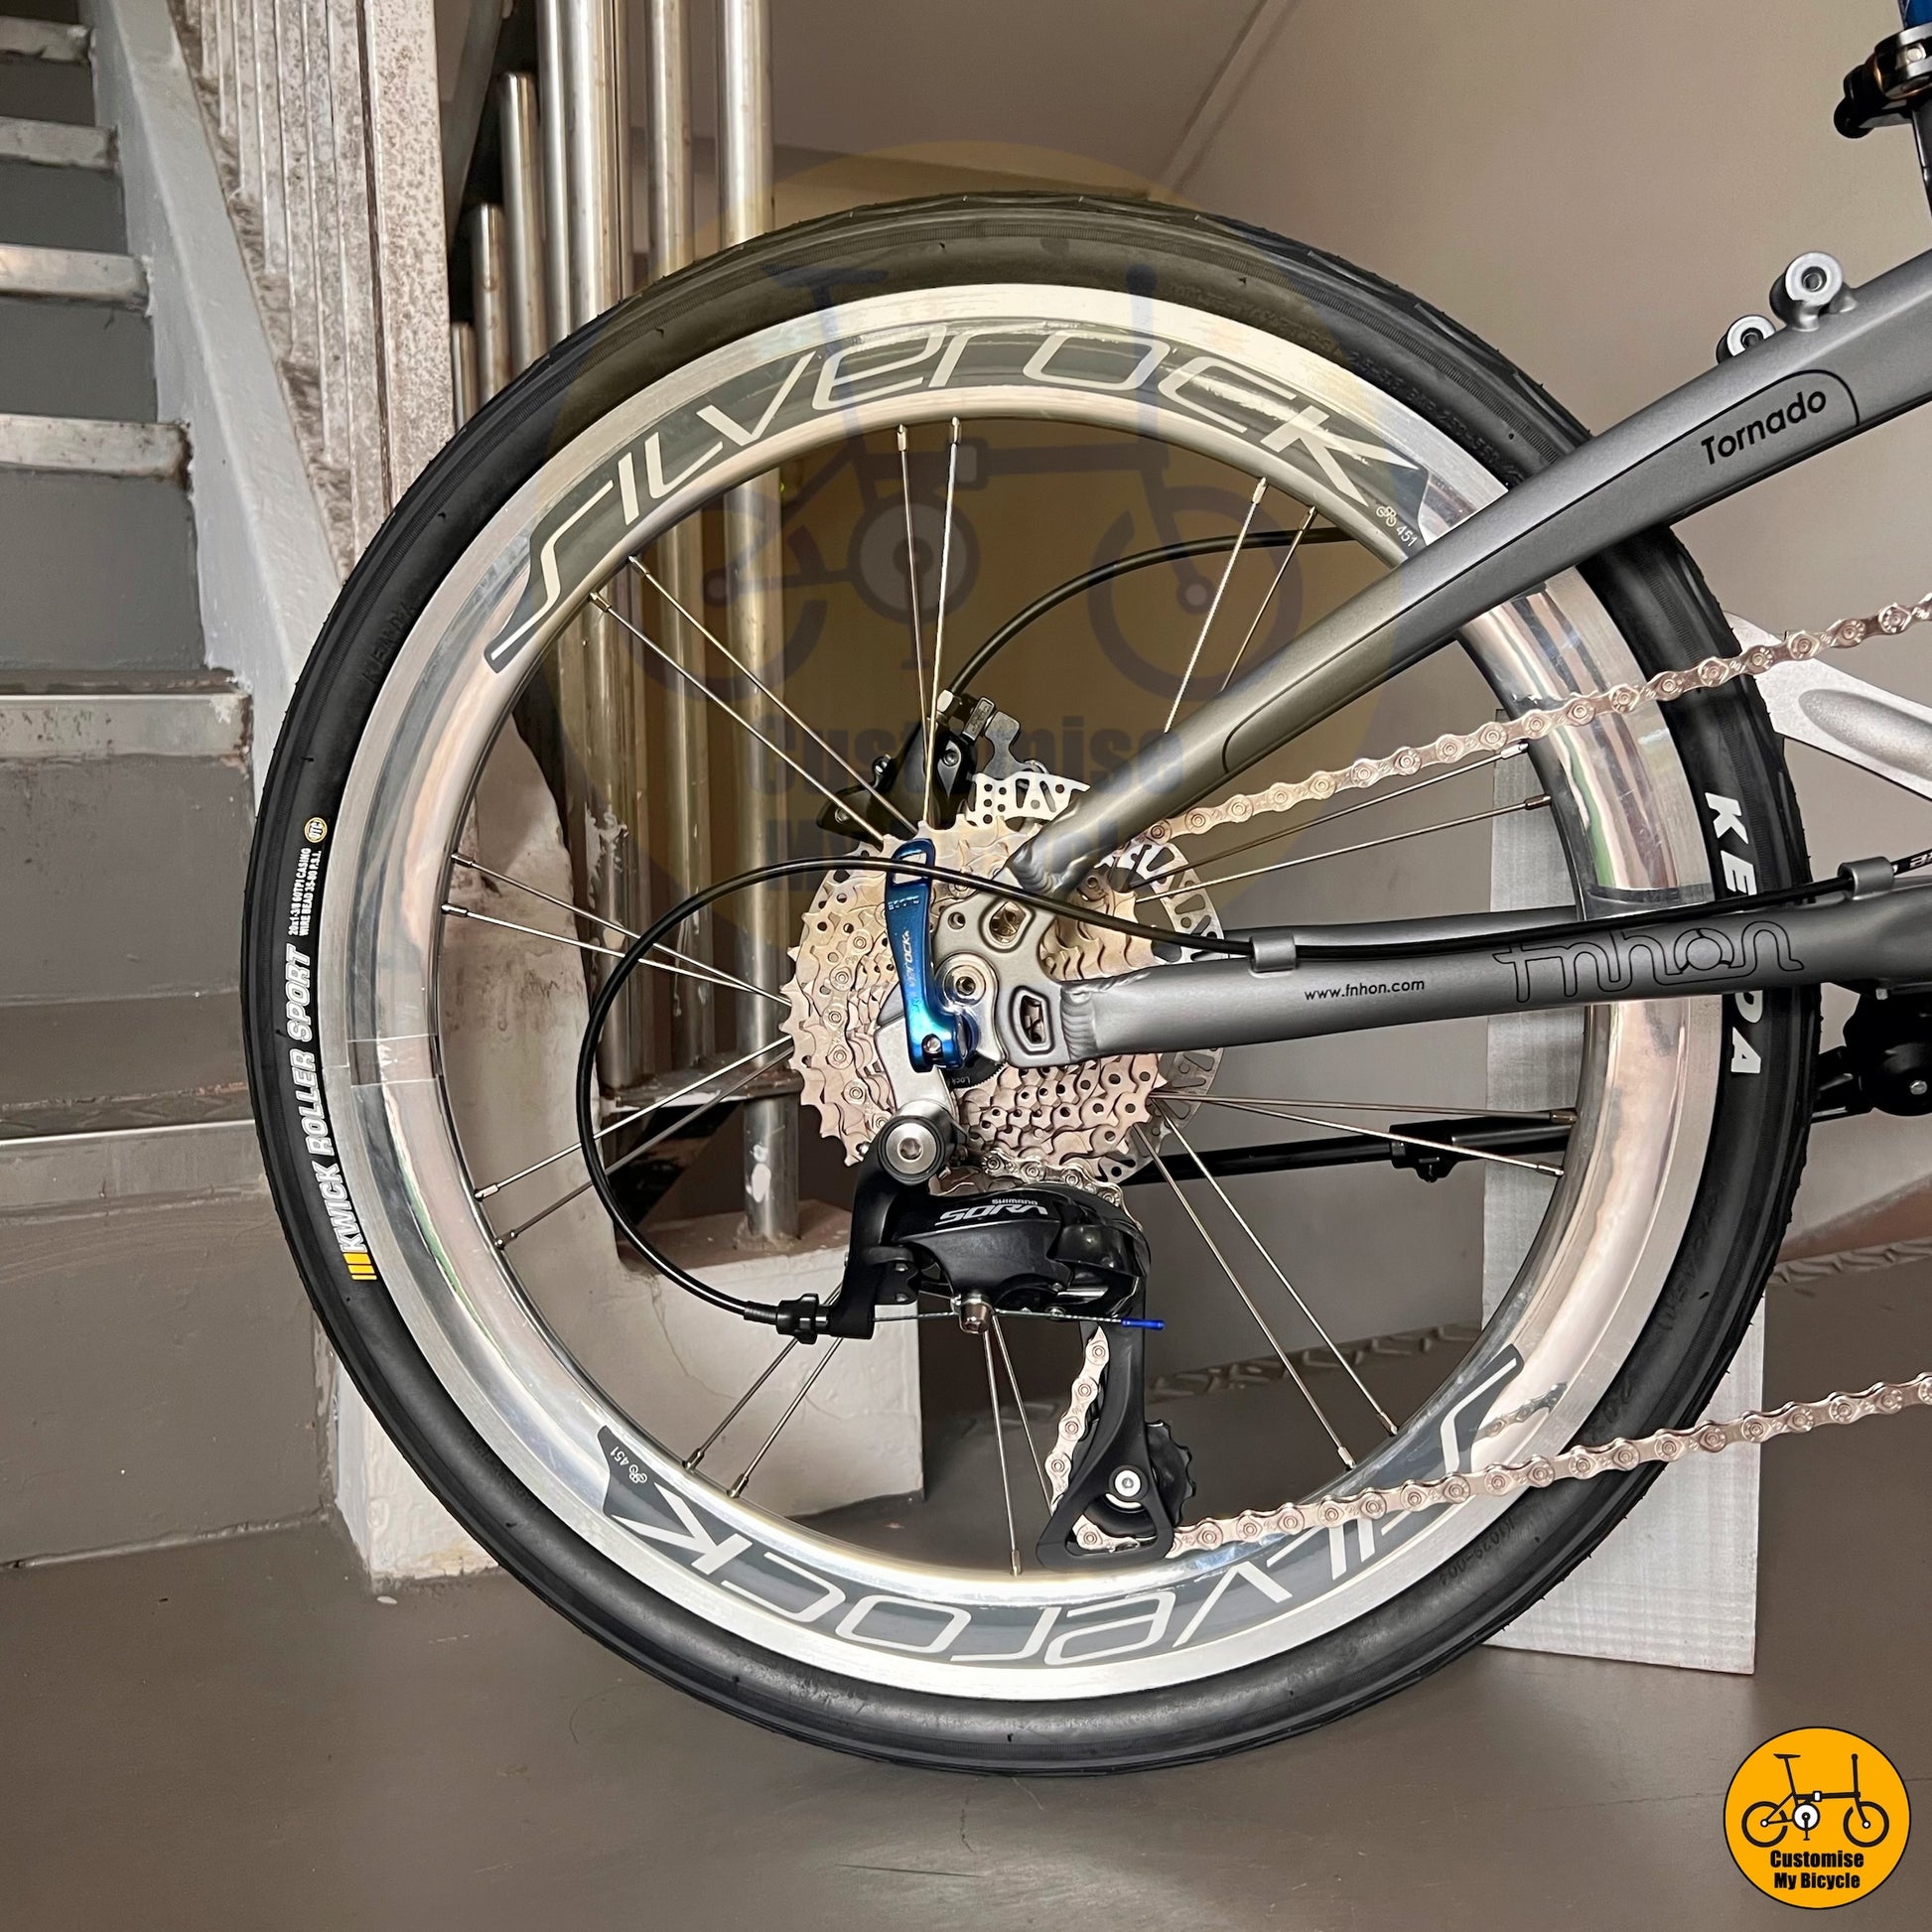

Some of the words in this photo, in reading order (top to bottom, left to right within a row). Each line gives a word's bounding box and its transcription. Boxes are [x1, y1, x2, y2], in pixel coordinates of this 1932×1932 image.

[1701, 390, 1828, 467] Tornado
[1396, 526, 1418, 547] 451
[296, 848, 312, 879] CASING
[301, 893, 314, 914] BEAD
[299, 914, 311, 936] WIRE
[1705, 791, 1762, 1075] KEDA
[1492, 920, 1804, 1004] fnhon
[285, 943, 314, 1043] SPORT
[1304, 976, 1426, 1001] www.fnhon.com
[289, 1047, 336, 1157] ROLLER
[311, 1160, 368, 1253] KWICK
[934, 1203, 1049, 1227] SORA
[610, 1446, 630, 1466] 451
